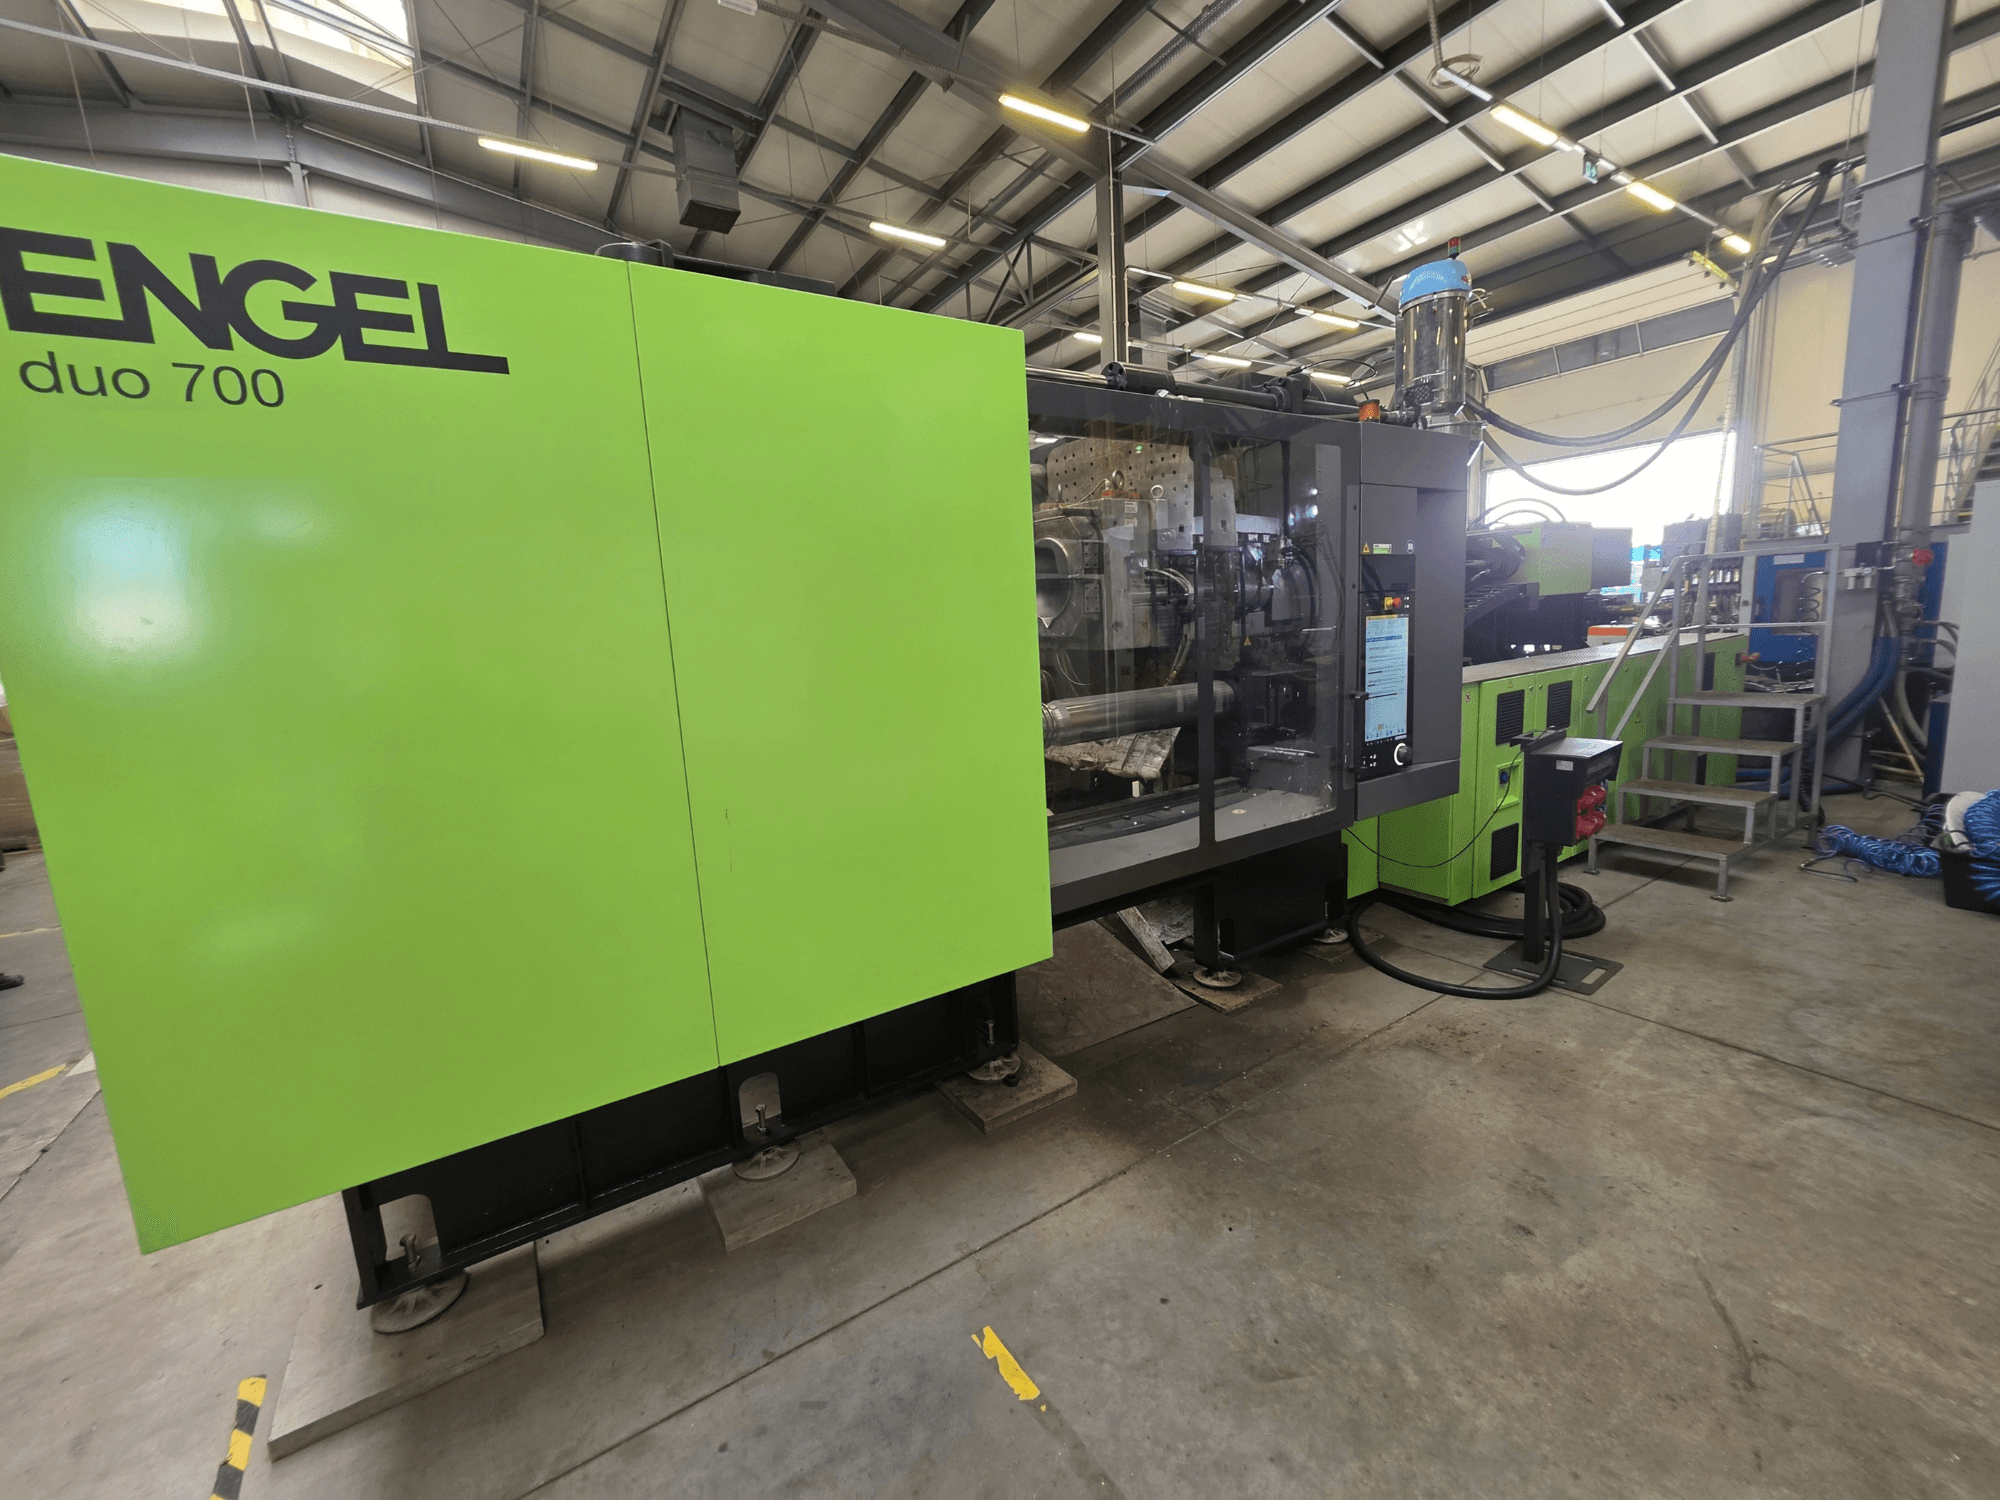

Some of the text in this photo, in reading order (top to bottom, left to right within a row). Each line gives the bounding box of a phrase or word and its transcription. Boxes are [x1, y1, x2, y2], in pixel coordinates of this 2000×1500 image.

[0, 227, 510, 374] ENGEL
[19, 351, 284, 407] duo 700
